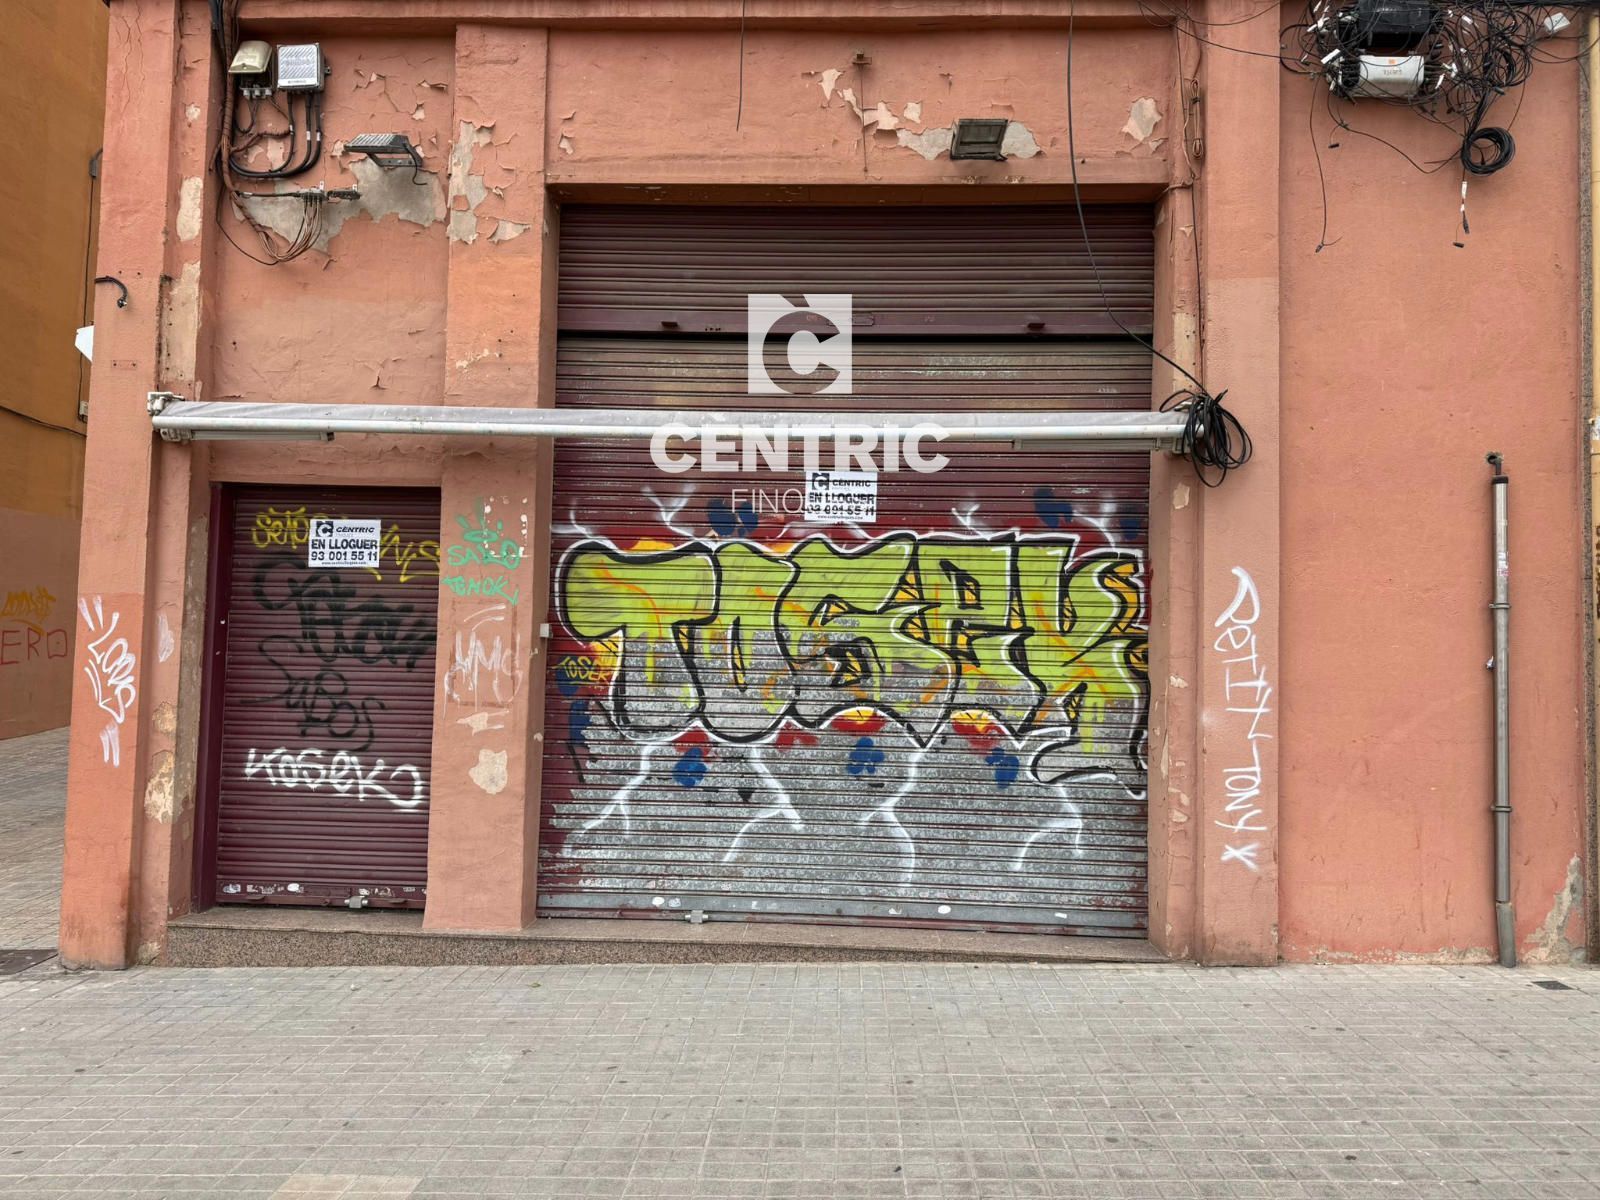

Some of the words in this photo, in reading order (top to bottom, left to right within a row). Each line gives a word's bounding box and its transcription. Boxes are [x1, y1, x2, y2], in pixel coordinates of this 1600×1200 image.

[809, 491, 822, 503] EN
[311, 539, 326, 550] EN
[328, 539, 378, 550] LLOGUER
[311, 551, 325, 561] 93
[328, 551, 347, 561] 001
[351, 551, 365, 561] 55
[368, 551, 378, 561] 11
